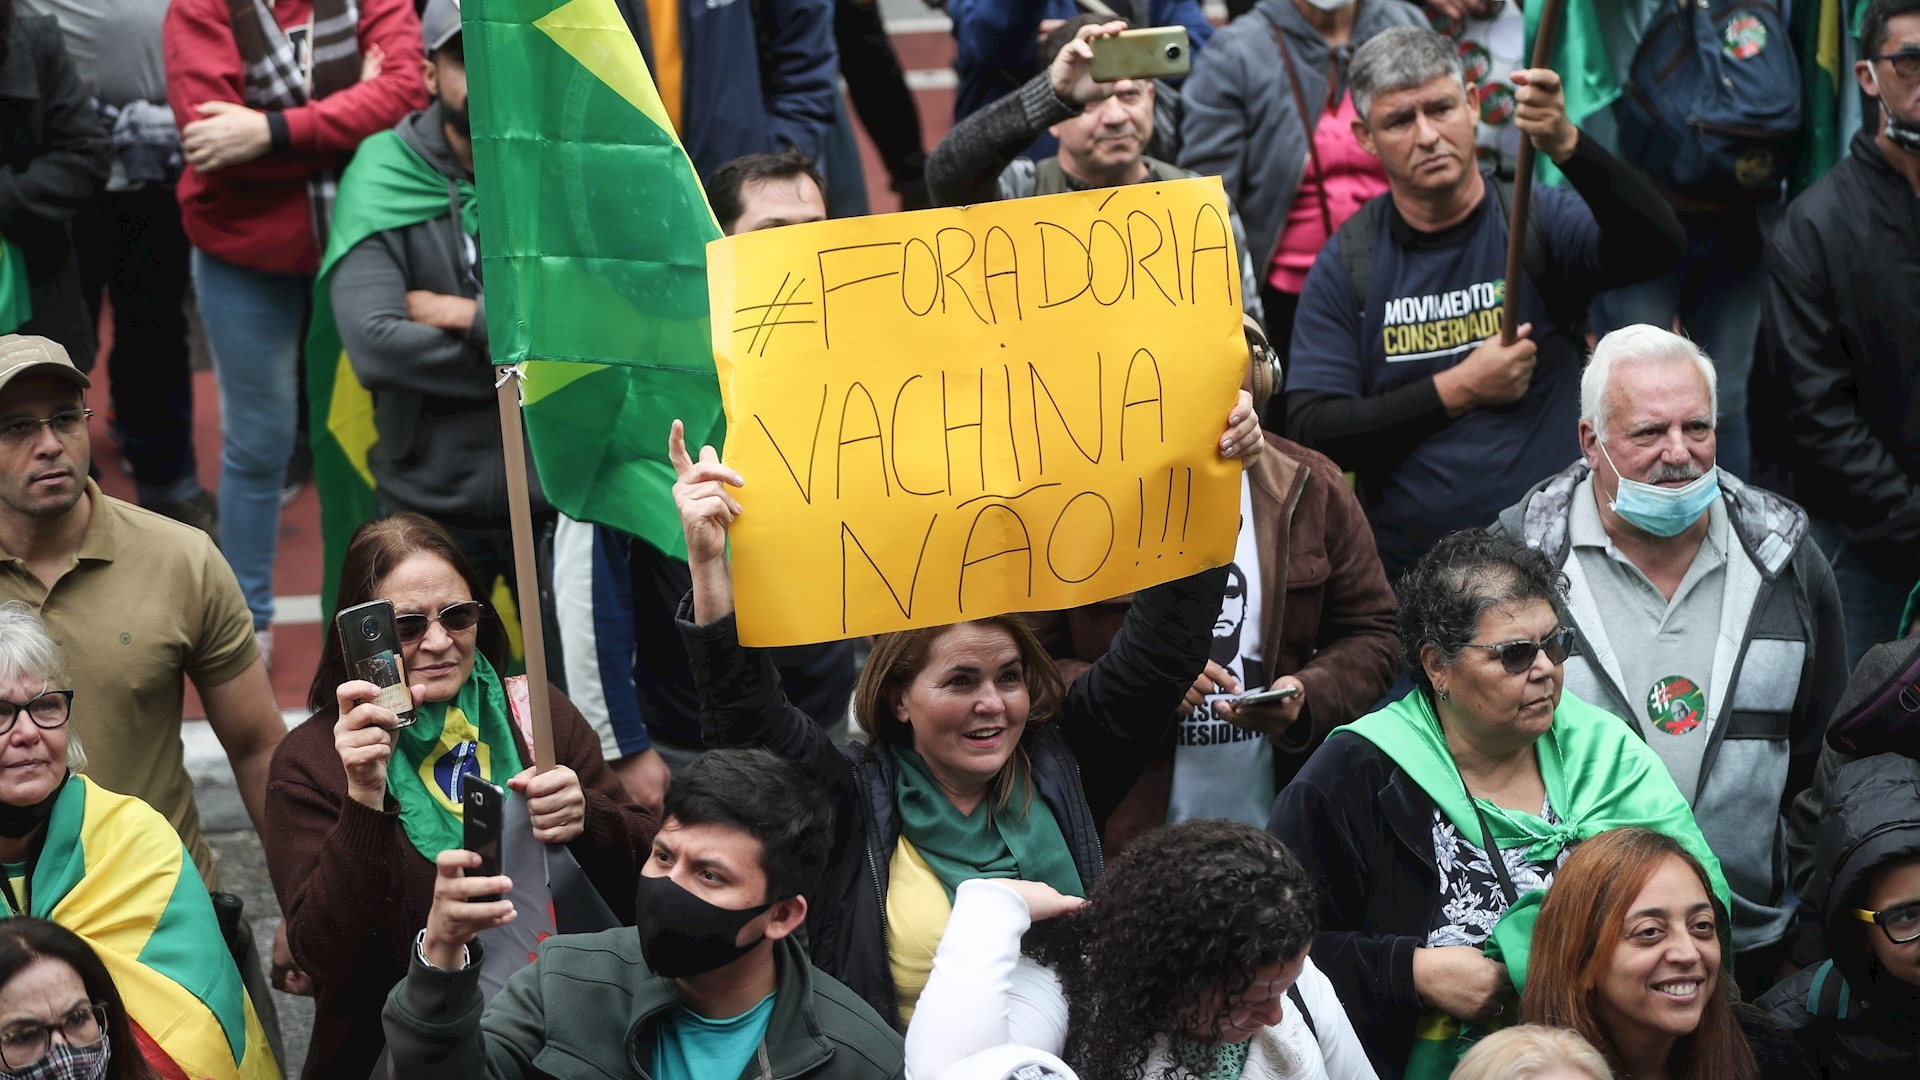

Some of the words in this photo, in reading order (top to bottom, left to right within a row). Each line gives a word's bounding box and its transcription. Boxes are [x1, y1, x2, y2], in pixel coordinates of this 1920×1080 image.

[1382, 306, 1505, 356] CONSERVADO
[1383, 281, 1496, 326] MOVIMENTO
[753, 343, 1165, 505] VACHINA
[840, 467, 1192, 634] NÃO!!!
